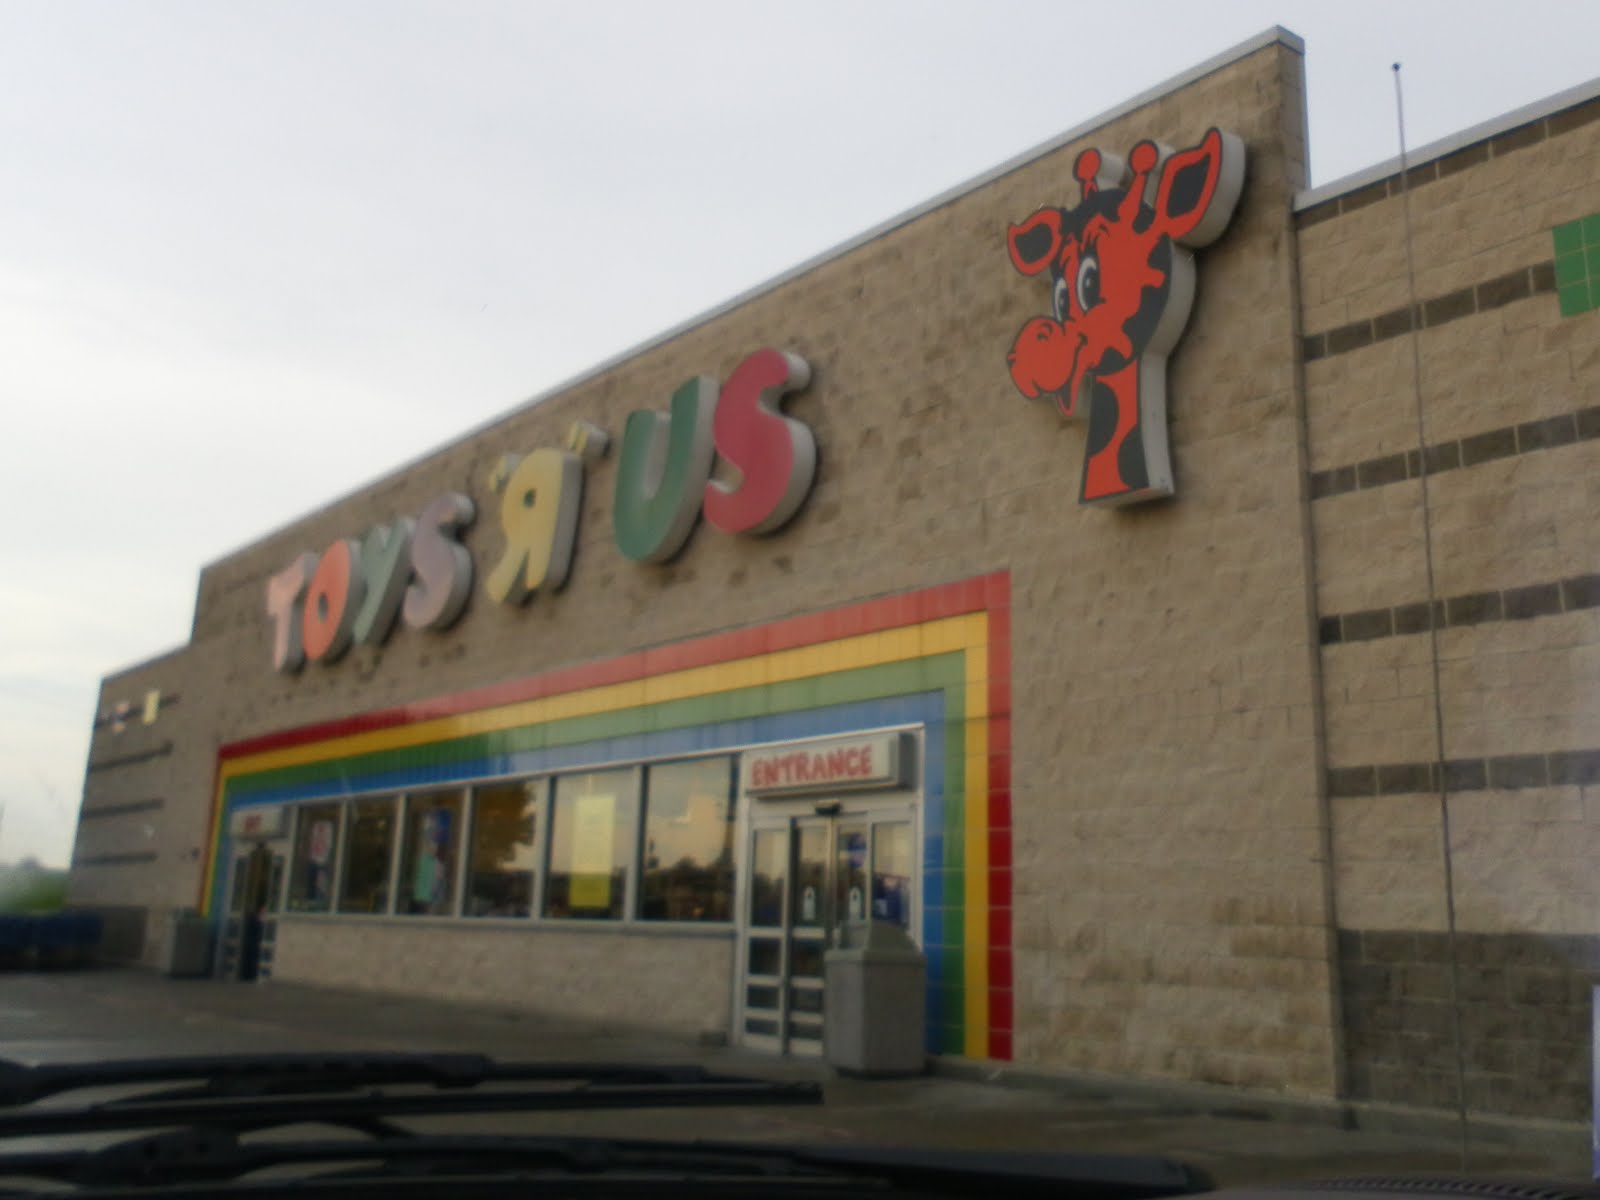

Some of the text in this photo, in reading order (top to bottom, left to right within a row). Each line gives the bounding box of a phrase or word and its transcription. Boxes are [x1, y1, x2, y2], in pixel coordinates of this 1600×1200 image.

[266, 492, 475, 673] TOYS
[613, 347, 816, 564] US
[752, 743, 873, 787] ENTRANCE
